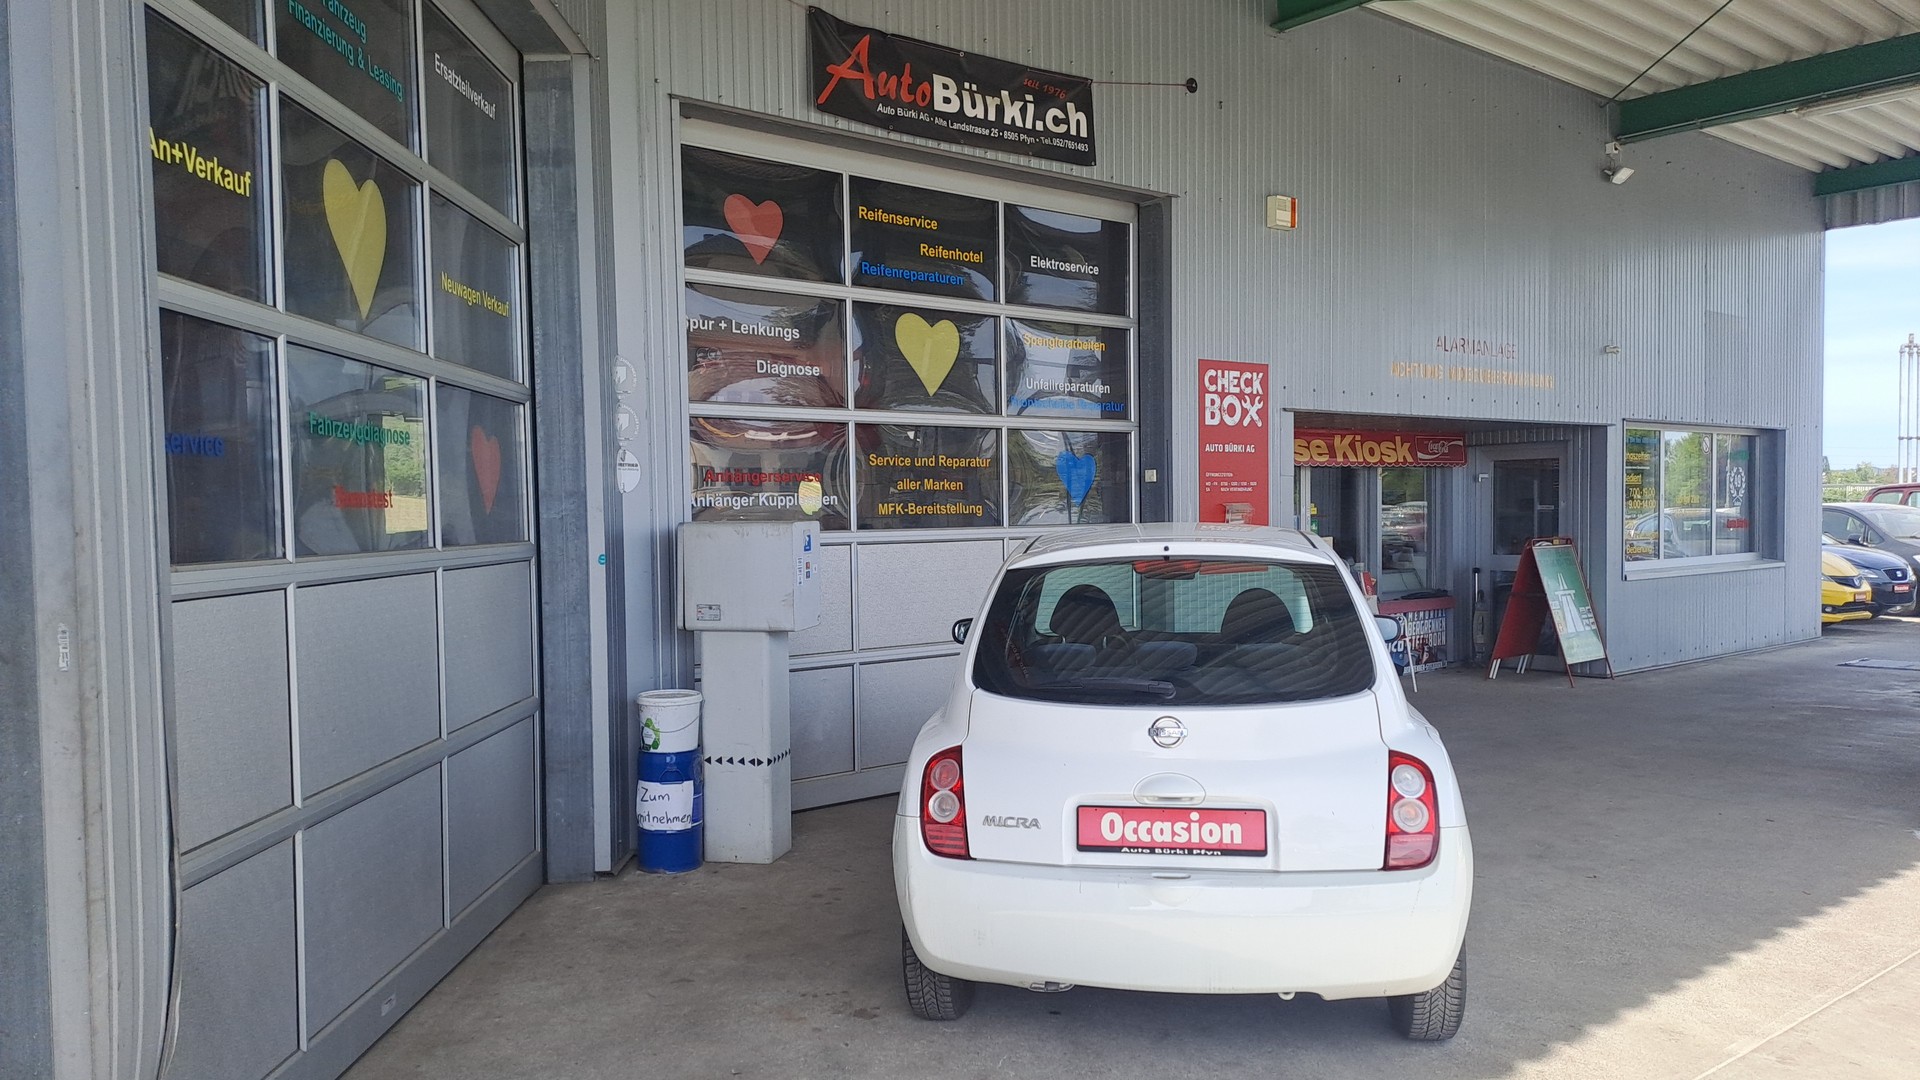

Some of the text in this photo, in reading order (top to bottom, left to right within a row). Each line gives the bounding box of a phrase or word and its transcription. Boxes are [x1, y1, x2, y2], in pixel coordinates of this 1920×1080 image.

[322, 0, 367, 44] ahrzeug
[288, 0, 404, 103] Finanzierung & Leasing
[434, 52, 496, 121] Ersatzteilverkauf
[1043, 84, 1067, 100] 1976
[876, 103, 895, 116] Auto
[897, 107, 918, 119] Bürki
[919, 112, 930, 122] AG
[948, 119, 990, 136] Landstrasse
[990, 128, 999, 138] 25
[1003, 130, 1019, 142] 8505
[1020, 133, 1036, 146] Pfyn
[858, 206, 938, 230] Reifenservice
[920, 243, 983, 264] Reifenhotel
[861, 261, 965, 286] Reifenreparaturen
[1030, 255, 1099, 275] Elektroservice
[441, 270, 509, 318] Neuwagen Verkauf
[686, 316, 715, 333] pur
[731, 319, 800, 341] Lenkungs
[756, 359, 820, 377] Diagnose
[1026, 377, 1111, 394] Unfallreparaturen
[1204, 368, 1264, 395] CHECK
[309, 411, 412, 448] Fahrzeugdiagnose
[1205, 442, 1255, 453] AUTO BÜRKI AG
[1334, 434, 1414, 463] Kiosk
[869, 453, 991, 469] Service und Reparatur
[897, 478, 964, 491] aller Marken
[759, 493, 838, 510] Kupplen
[878, 502, 983, 517] MFK-Bereitstellung
[641, 786, 670, 802] Zum
[982, 815, 1041, 829] MICRA
[1101, 812, 1242, 844] Occasion
